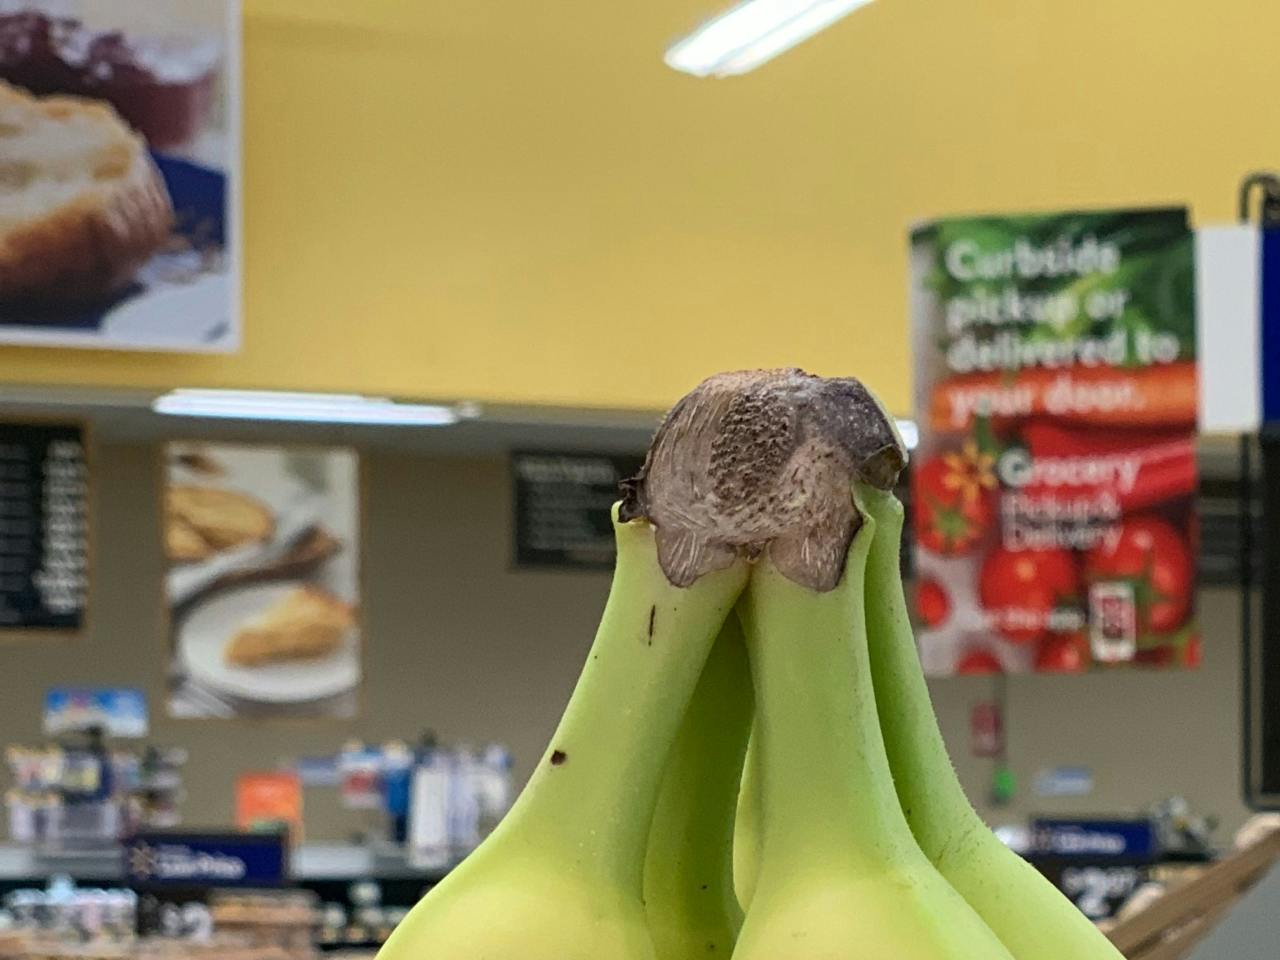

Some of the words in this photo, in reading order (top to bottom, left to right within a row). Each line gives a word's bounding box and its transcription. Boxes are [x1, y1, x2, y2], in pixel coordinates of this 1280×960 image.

[945, 235, 1121, 280] Curbside
[947, 284, 1079, 334] pickup
[1084, 290, 1130, 320] or
[947, 331, 1128, 372] delivered
[1135, 324, 1181, 364] to
[950, 385, 1034, 429] your
[999, 449, 1143, 496] Grocery
